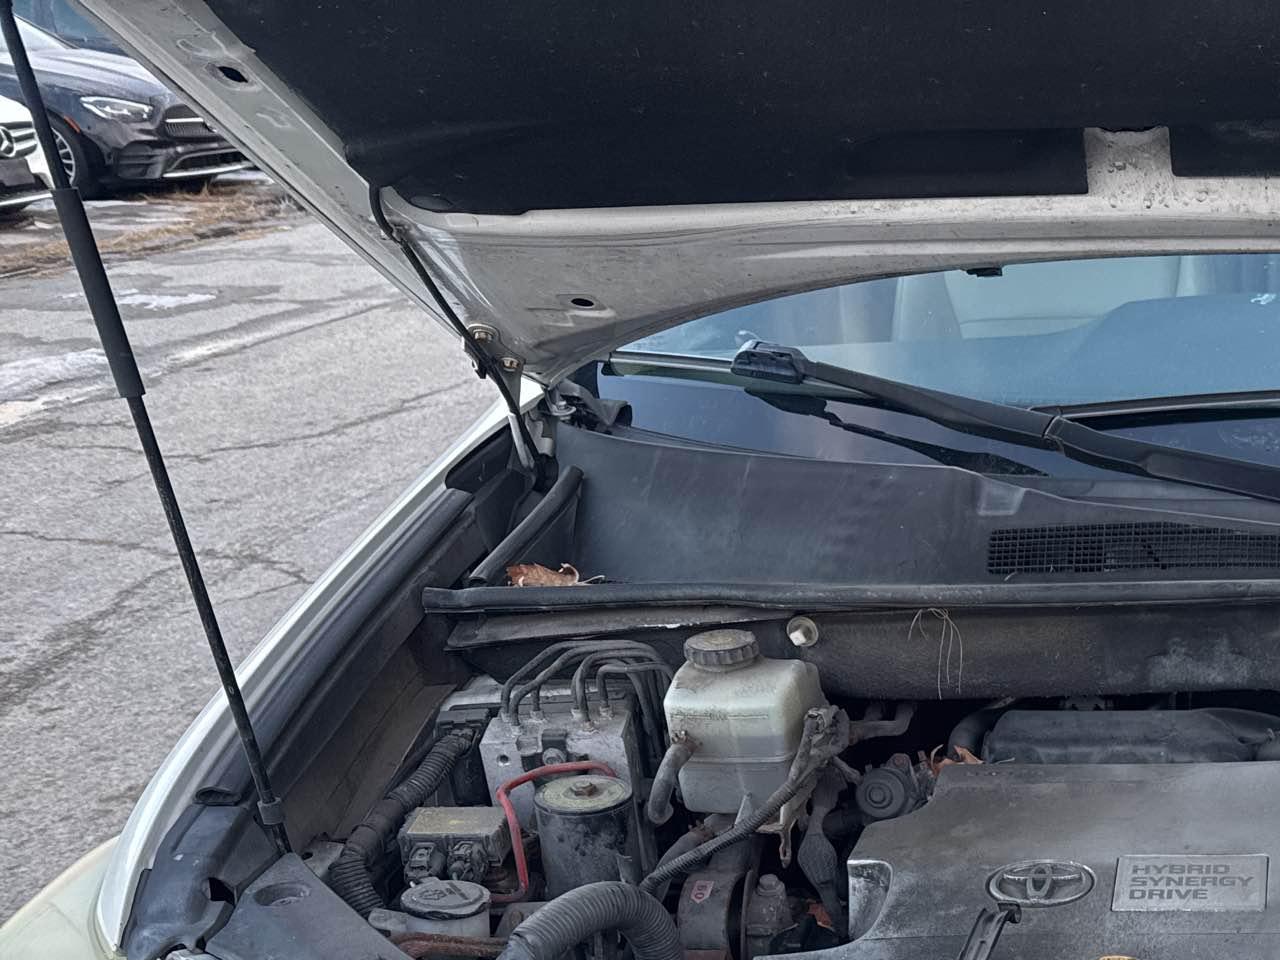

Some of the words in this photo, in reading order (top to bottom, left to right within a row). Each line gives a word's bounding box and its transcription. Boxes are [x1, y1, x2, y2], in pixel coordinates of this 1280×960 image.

[1132, 864, 1230, 875] HYBRID
[1129, 876, 1254, 887] SYNERGY
[1128, 889, 1209, 900] DRIVE
